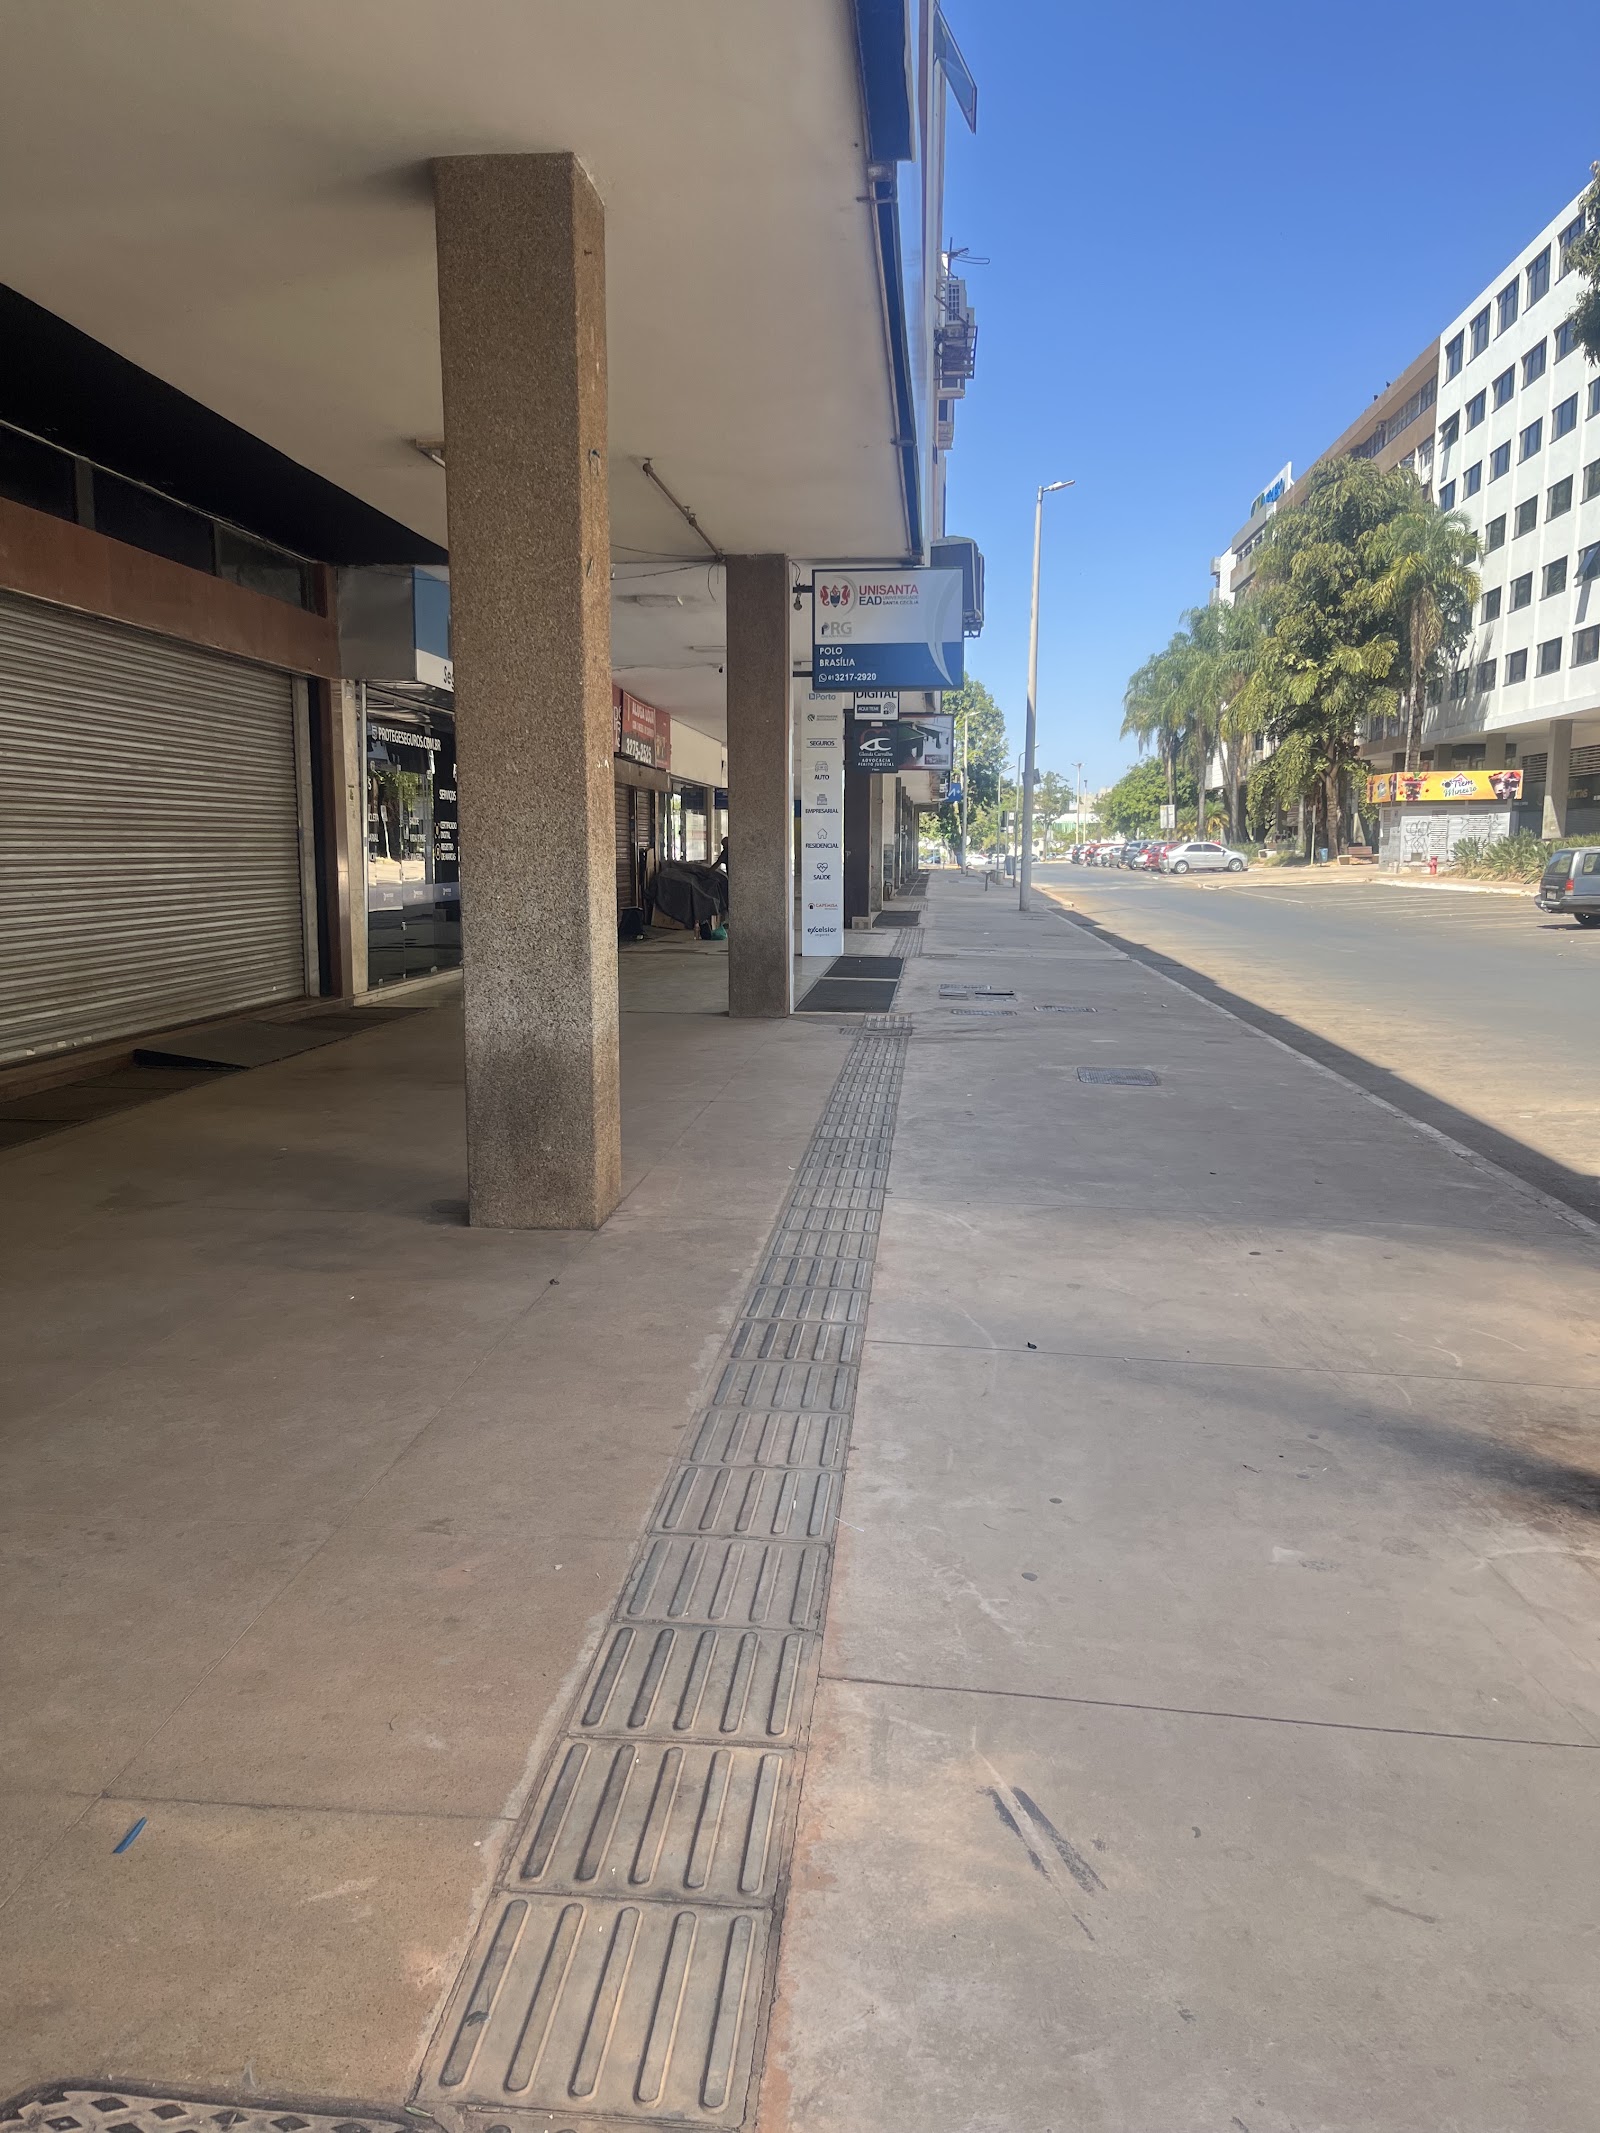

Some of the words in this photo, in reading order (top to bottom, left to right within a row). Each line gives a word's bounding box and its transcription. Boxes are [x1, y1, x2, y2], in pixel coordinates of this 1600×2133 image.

[858, 584, 919, 596] UNISANTA
[859, 595, 882, 606] EAD
[819, 647, 843, 655] POLO
[819, 657, 856, 667] BRASÍLIA
[807, 926, 837, 935] excelsior
